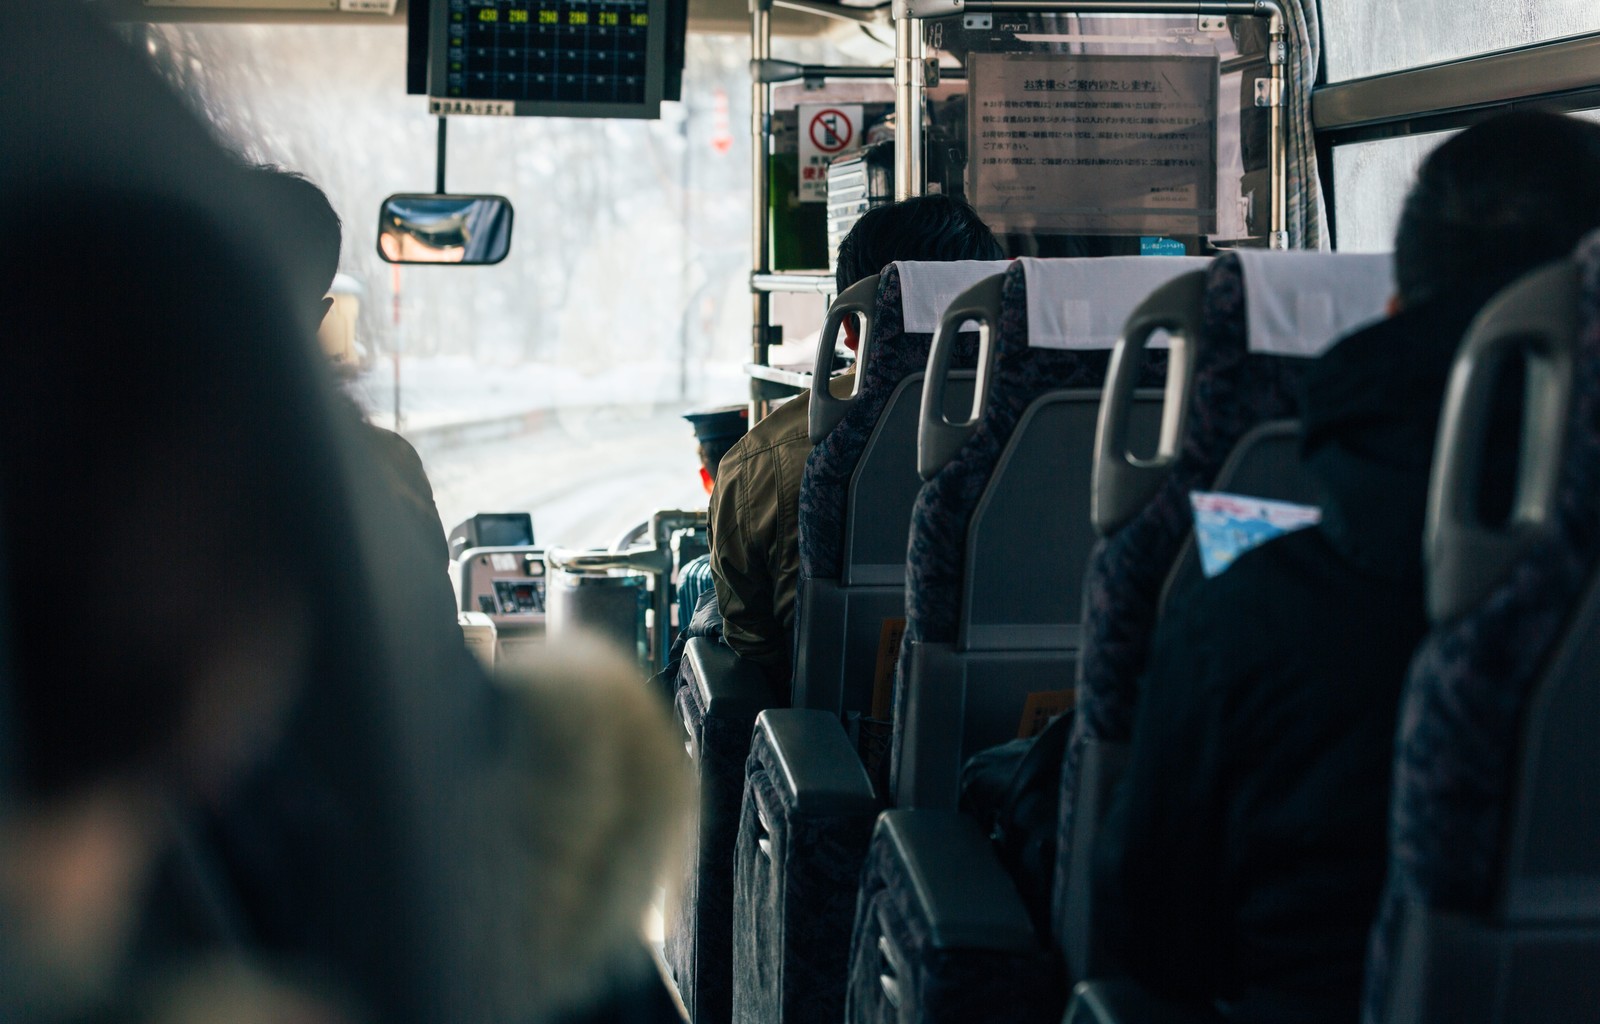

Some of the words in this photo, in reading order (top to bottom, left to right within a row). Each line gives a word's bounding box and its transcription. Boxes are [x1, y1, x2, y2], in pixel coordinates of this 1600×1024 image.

[479, 9, 498, 21] 430
[1024, 79, 1157, 91] お客様へご案内いたします。
